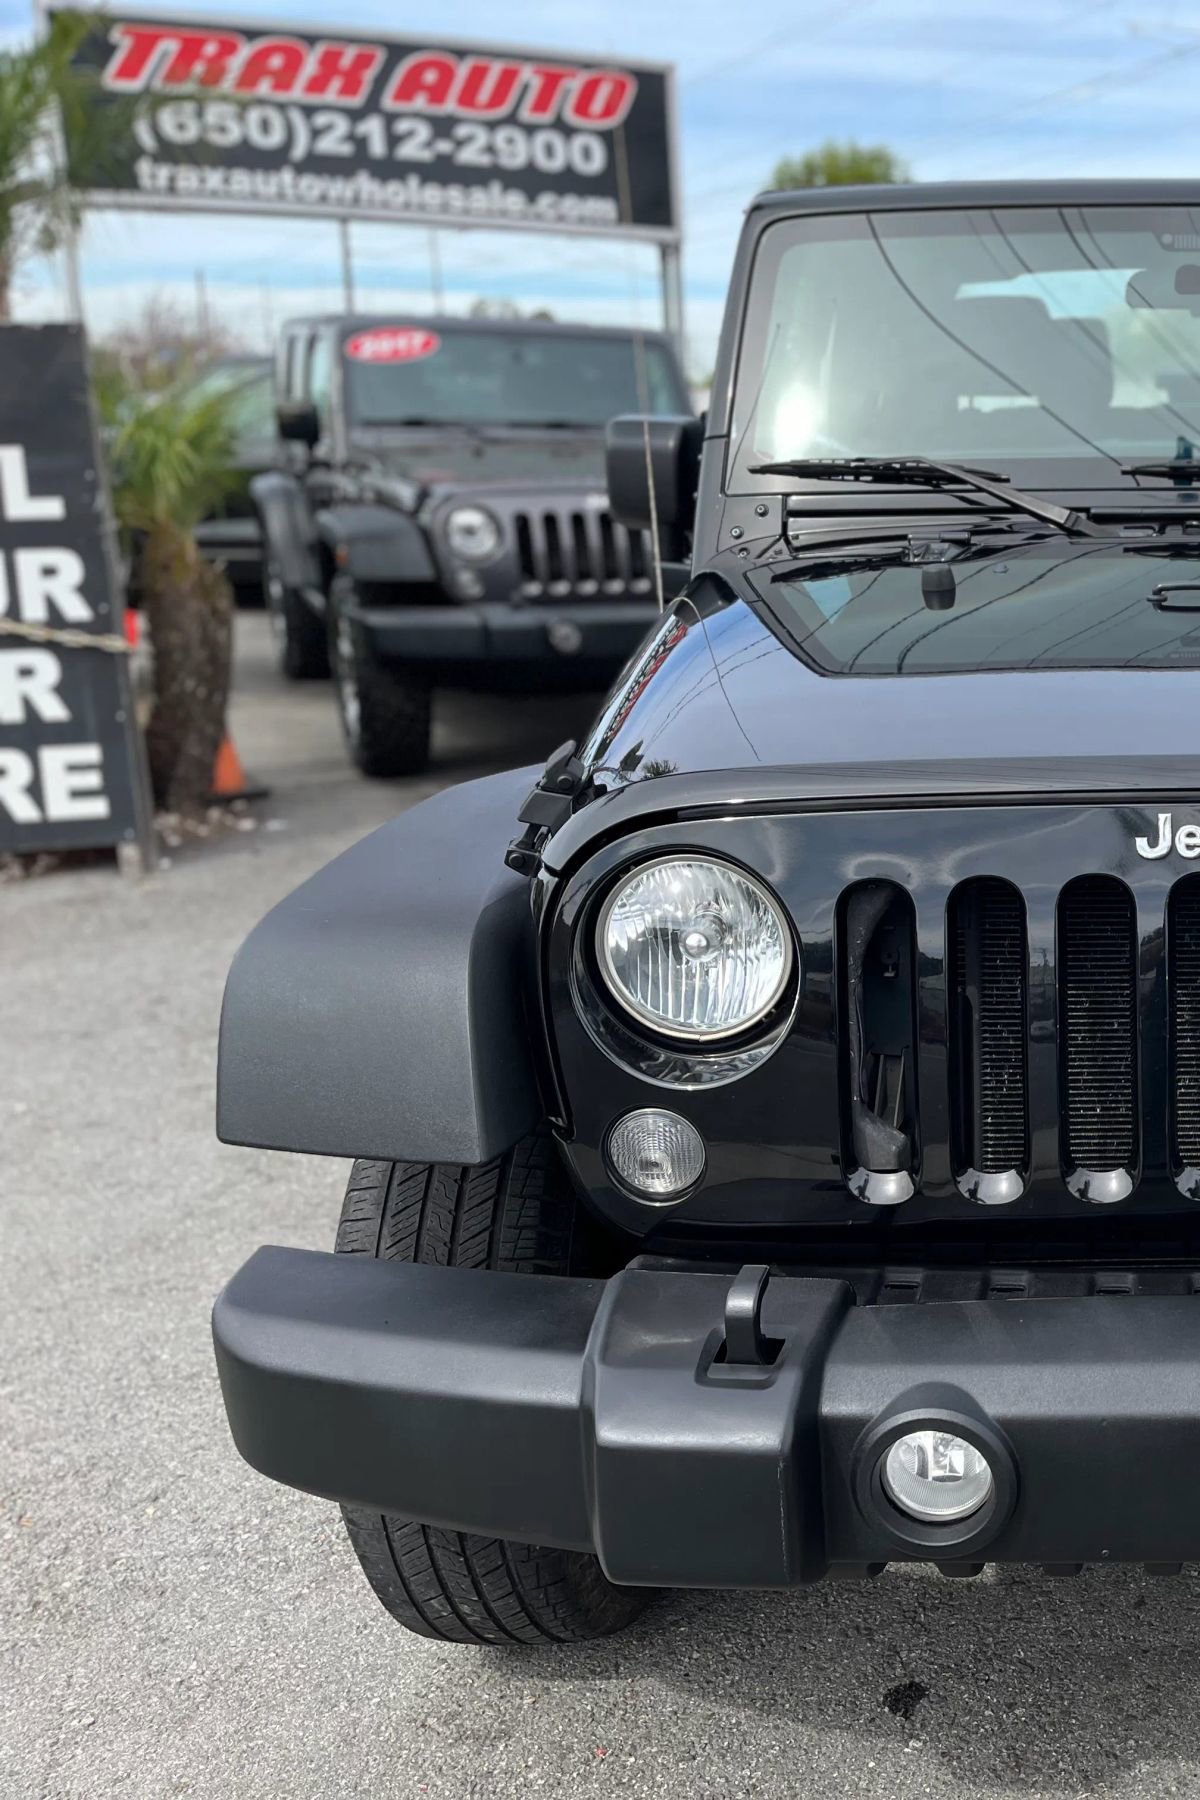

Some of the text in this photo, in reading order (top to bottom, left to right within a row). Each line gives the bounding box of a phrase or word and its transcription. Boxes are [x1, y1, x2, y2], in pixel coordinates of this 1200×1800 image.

[102, 22, 638, 131] TRAX AUTO
[133, 99, 608, 176] (650)212-2900
[134, 154, 619, 225] traxautowholesale.com
